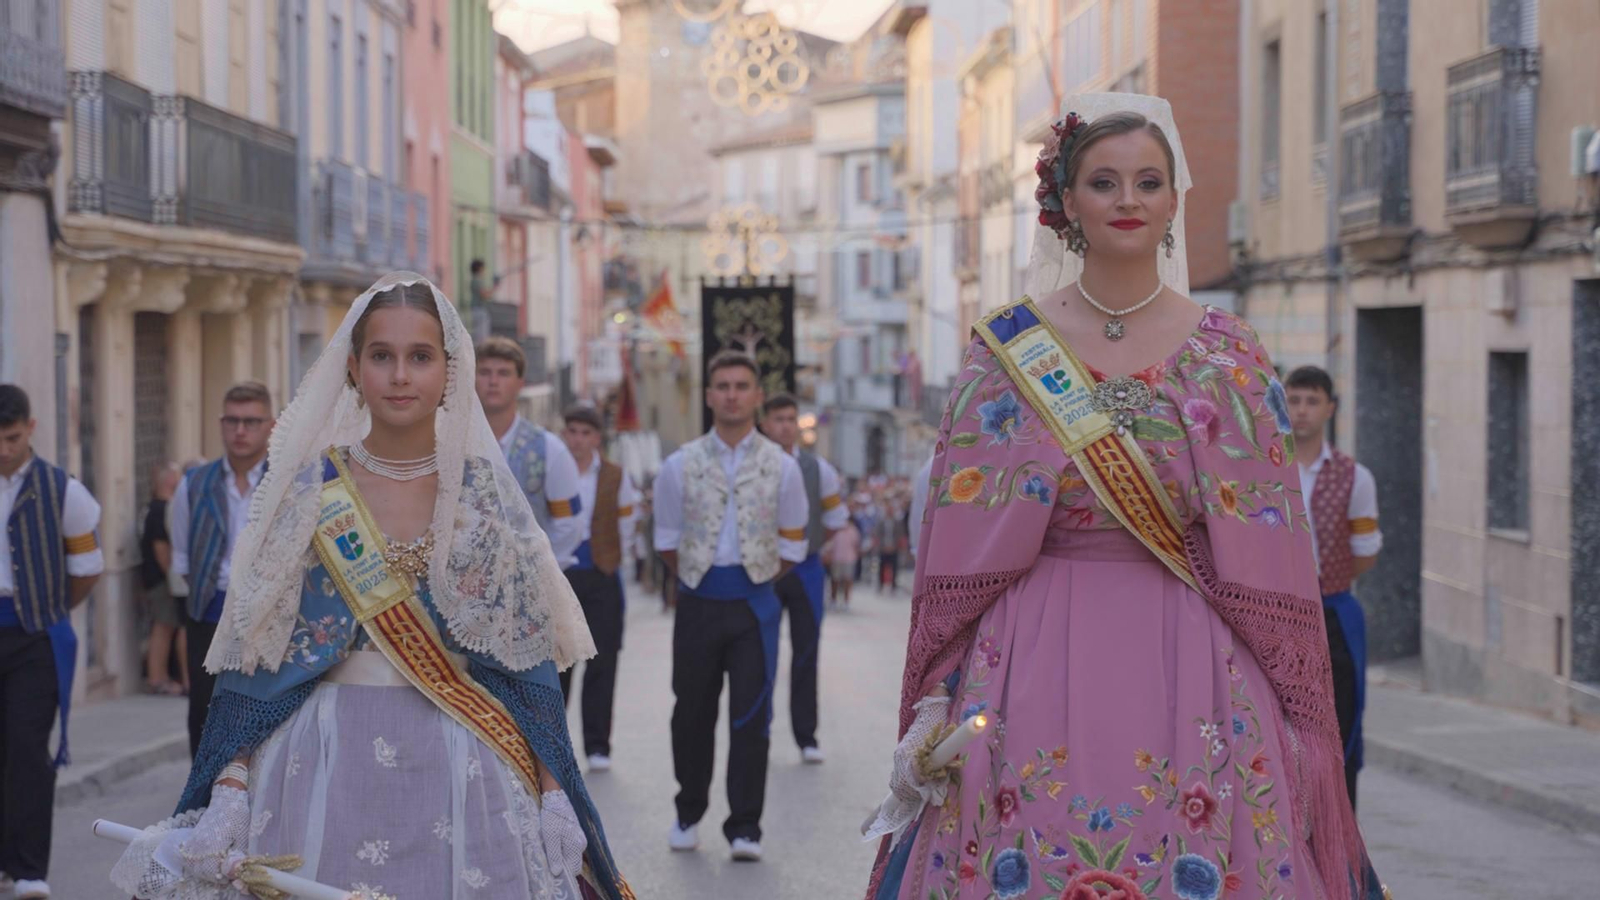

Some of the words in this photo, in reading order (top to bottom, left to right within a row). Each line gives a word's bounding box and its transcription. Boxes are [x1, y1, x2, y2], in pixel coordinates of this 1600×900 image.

[1018, 345, 1055, 367] PATRONALS
[1021, 341, 1044, 358] FESTES
[1050, 400, 1059, 409] LA
[1059, 390, 1076, 402] FONT
[1053, 407, 1063, 416] LA
[1063, 402, 1094, 426] 2025
[320, 501, 341, 513] ESTES
[1097, 448, 1161, 542] Reina
[343, 567, 352, 576] LA
[352, 557, 368, 570] FONT
[369, 551, 379, 560] DE
[346, 575, 355, 584] LA
[356, 559, 383, 577] FIGUERA
[356, 570, 387, 594] 2025
[392, 620, 455, 695] Reina
